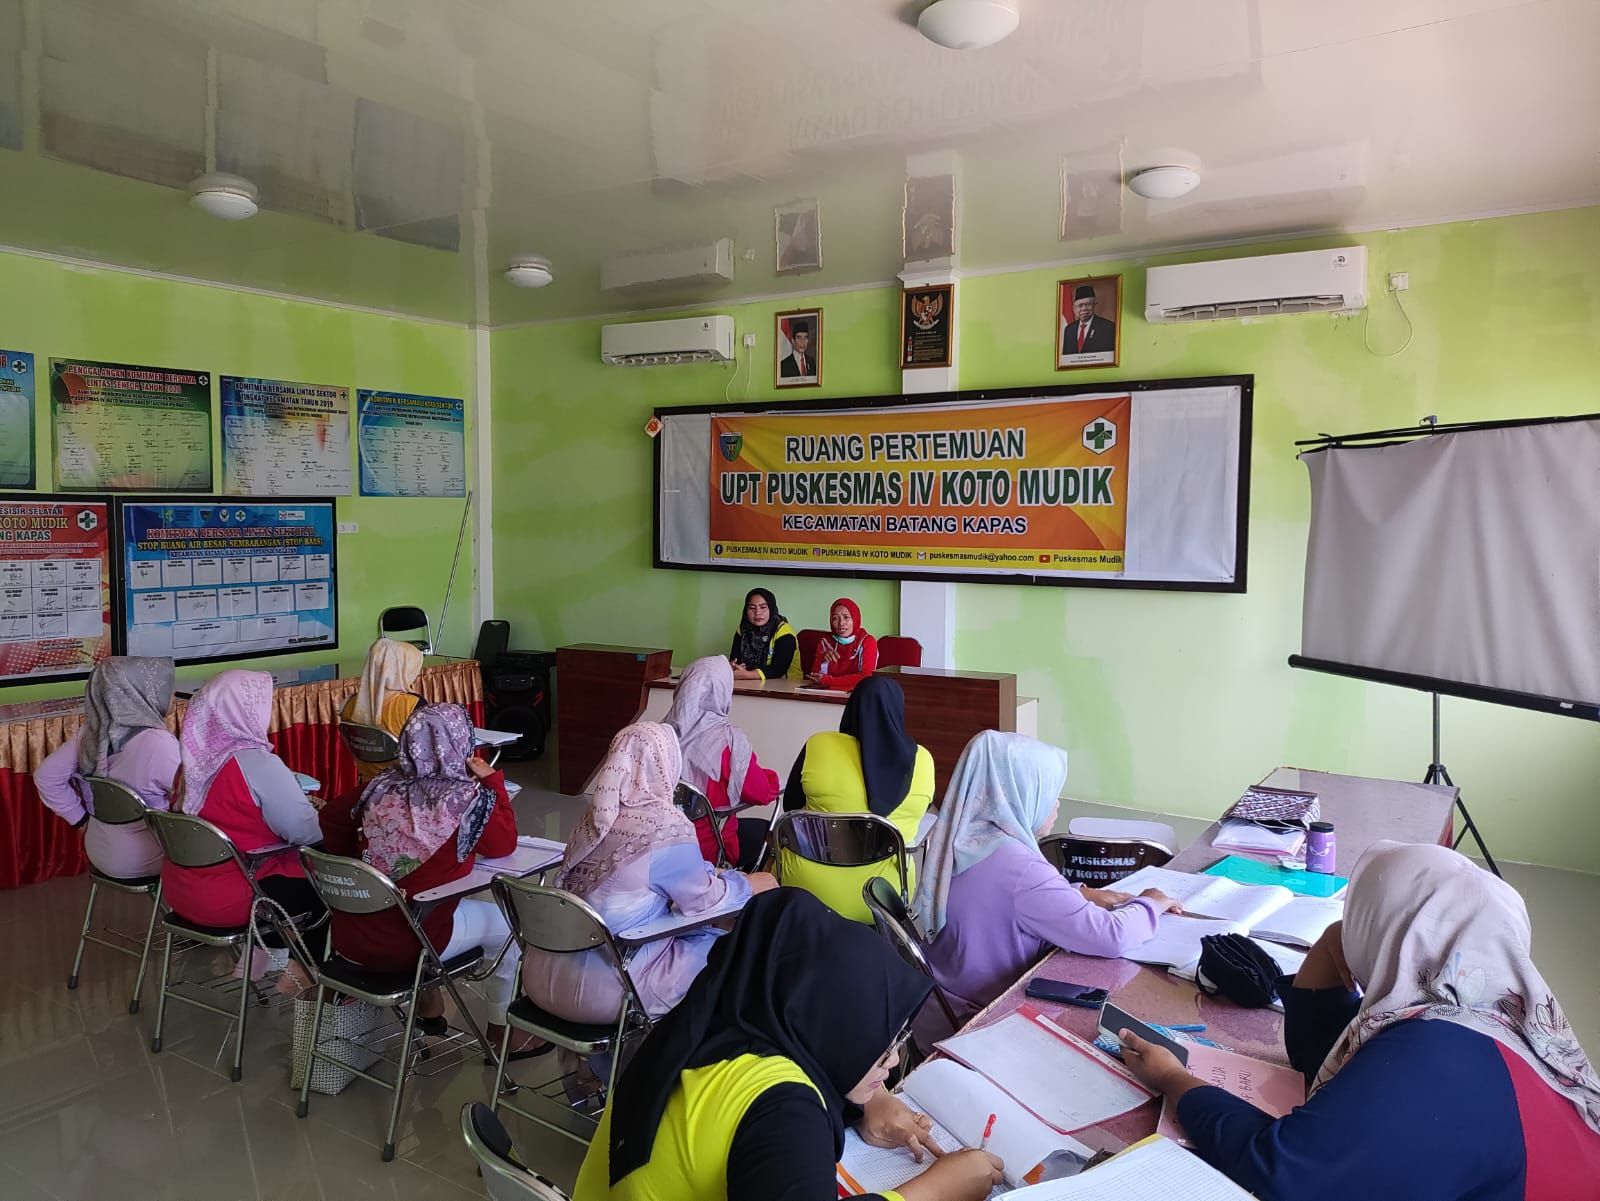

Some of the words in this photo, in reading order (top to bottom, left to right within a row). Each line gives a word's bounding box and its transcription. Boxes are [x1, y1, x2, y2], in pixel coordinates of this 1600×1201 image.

[68, 365, 125, 378] PENGGALANGAN
[127, 370, 163, 381] KOMITMEN
[165, 373, 196, 384] BERSAMA
[87, 378, 111, 388] LINTAS
[112, 380, 139, 390] SEKTOR
[141, 382, 163, 392] TAHUN
[235, 382, 267, 392] KOMITMEN
[268, 385, 295, 394] BERSAMA
[297, 388, 315, 396] LINTAS
[316, 390, 336, 398] SEKTOR
[301, 398, 319, 406] TAHUN
[786, 435, 863, 463] RUANG
[871, 429, 1024, 461] PERTEMUAN
[722, 473, 761, 504] UPT
[767, 472, 902, 505] PUSKESMAS
[909, 471, 934, 505] IV
[941, 470, 1010, 505] KOTO
[1019, 467, 1113, 505] MUDIK
[31, 517, 69, 529] MUDIK
[783, 515, 881, 531] KECAMATAN
[886, 517, 957, 532] BATANG
[963, 517, 1027, 533] KAPAS
[16, 531, 51, 541] KAPAS
[147, 528, 198, 539] KOMITMEN
[200, 528, 241, 538] BERSAMA
[243, 527, 273, 537] LINTAS
[137, 541, 159, 550] STOP
[160, 541, 186, 550] BUANG
[189, 540, 201, 549] AIR
[203, 540, 227, 548] BESAR
[229, 539, 281, 547] SEMBARANGAN
[726, 546, 762, 554] PUSKESMAS
[770, 547, 787, 555] KOTO
[821, 549, 861, 557] PUSKESMAS
[870, 550, 888, 558] KOTO
[891, 551, 912, 559] MUDIK
[930, 552, 1034, 562] puskesmasmudik@yahoo.com
[1053, 555, 1097, 563] Puskesmas
[1100, 555, 1122, 563] Mudik
[1071, 855, 1136, 866] PUSKESMAS
[1076, 869, 1107, 880] KOTO
